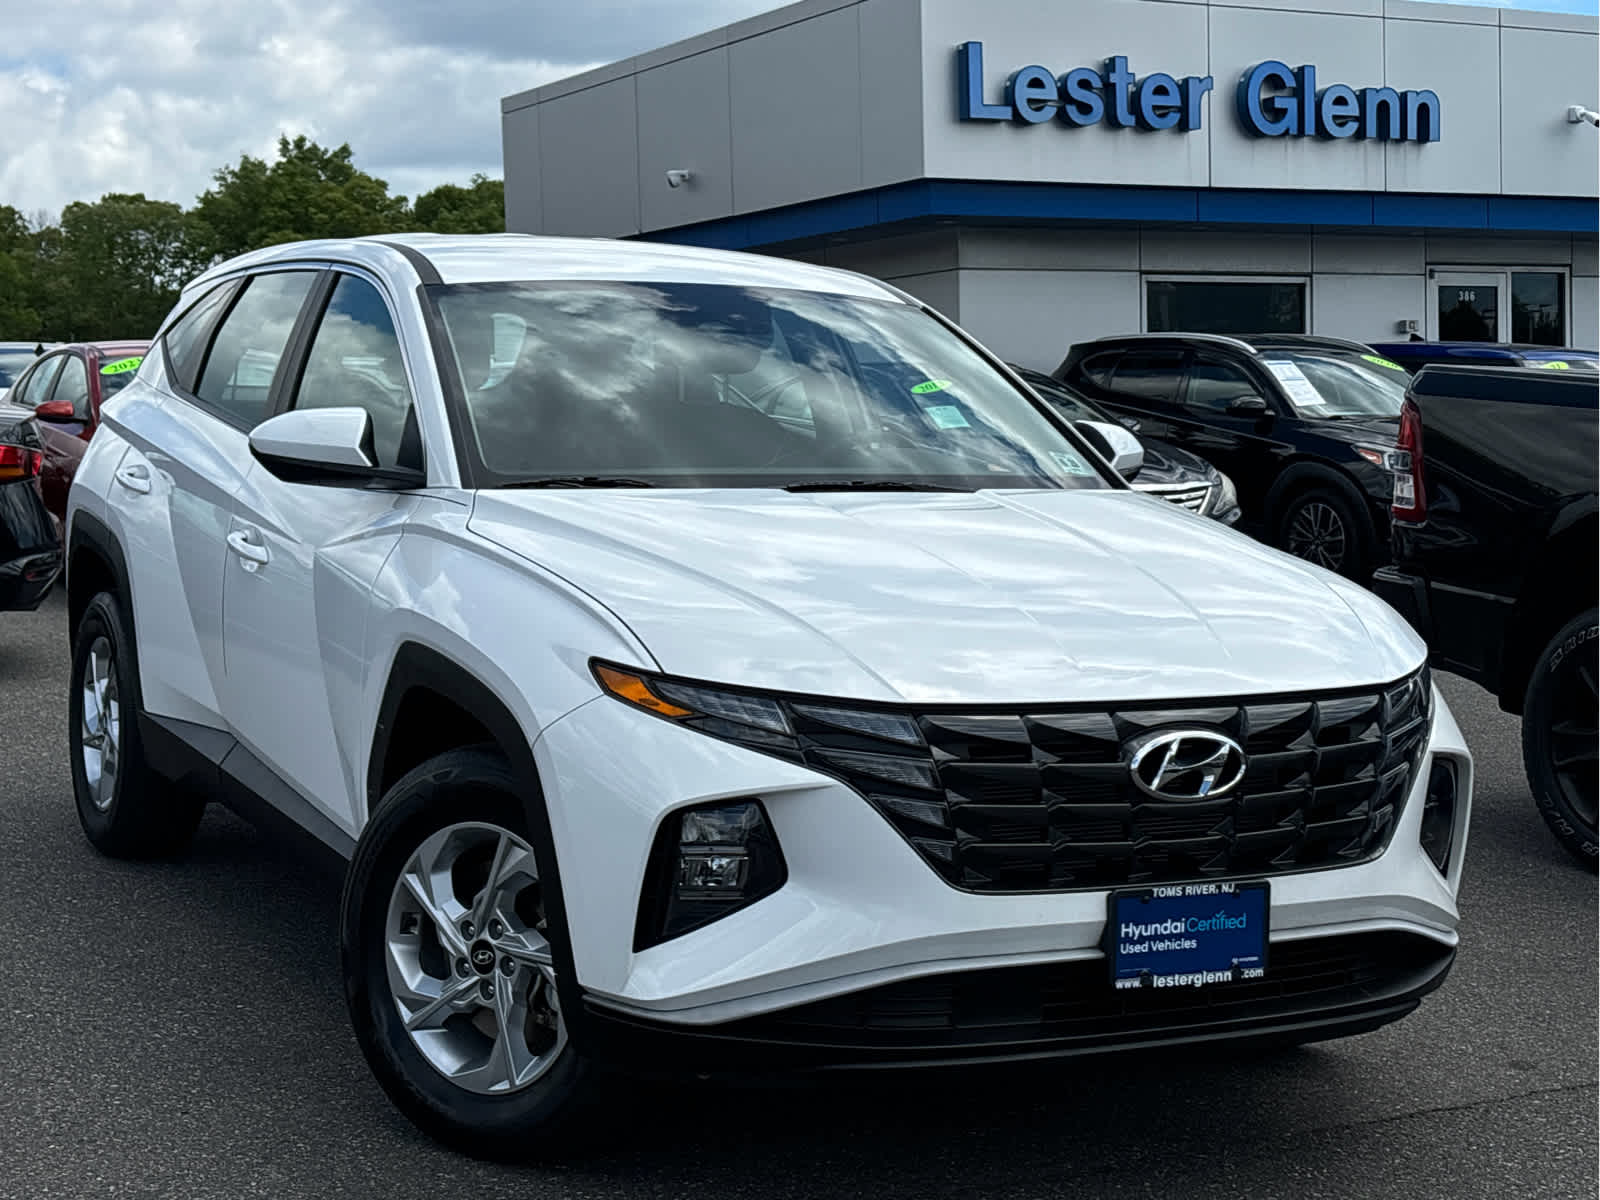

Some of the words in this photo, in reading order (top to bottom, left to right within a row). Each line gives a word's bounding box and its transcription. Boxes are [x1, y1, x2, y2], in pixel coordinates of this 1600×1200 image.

[957, 41, 1213, 131] Lester
[1237, 60, 1441, 143] Glenn
[1458, 290, 1476, 302] 386
[1152, 886, 1183, 898] TOMS
[1185, 884, 1219, 896] RIVER,
[1120, 917, 1186, 940] Hyundai
[1186, 911, 1247, 933] Certified
[1120, 940, 1149, 955] Used
[1150, 938, 1198, 952] Vehicles
[1152, 970, 1232, 988] lesterglenn
